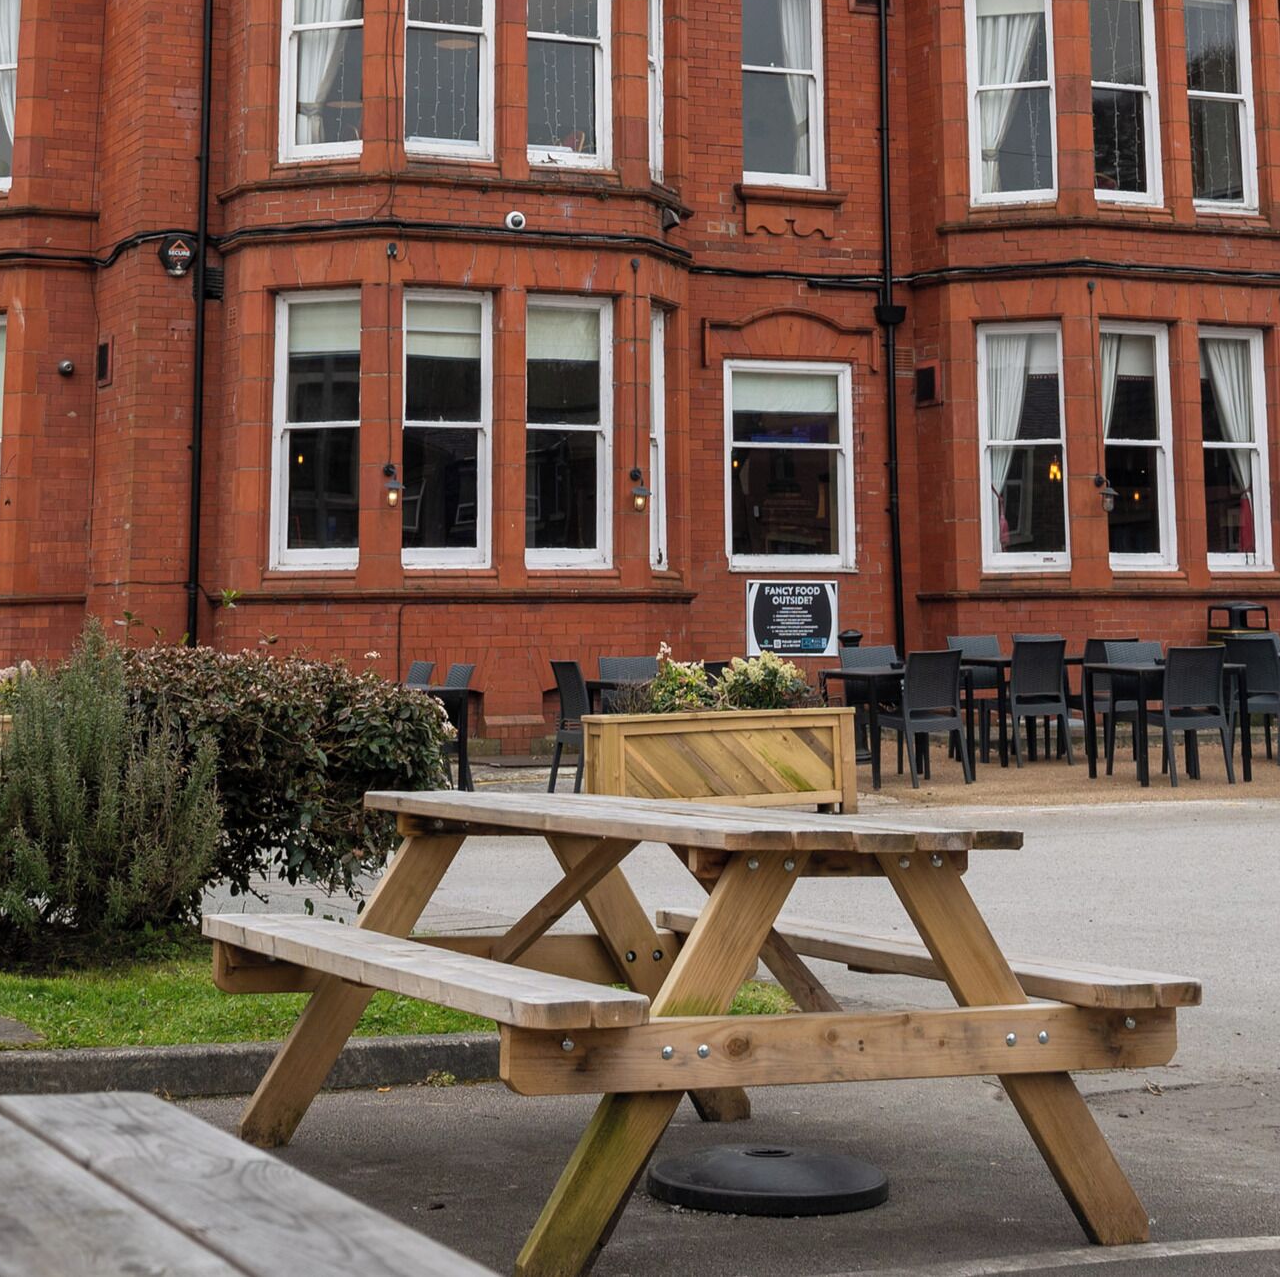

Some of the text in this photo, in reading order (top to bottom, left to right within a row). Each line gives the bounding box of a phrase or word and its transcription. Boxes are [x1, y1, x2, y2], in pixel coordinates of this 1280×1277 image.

[764, 586, 821, 595] FANCY FOOD
[772, 596, 814, 605] OUTSIDE?
